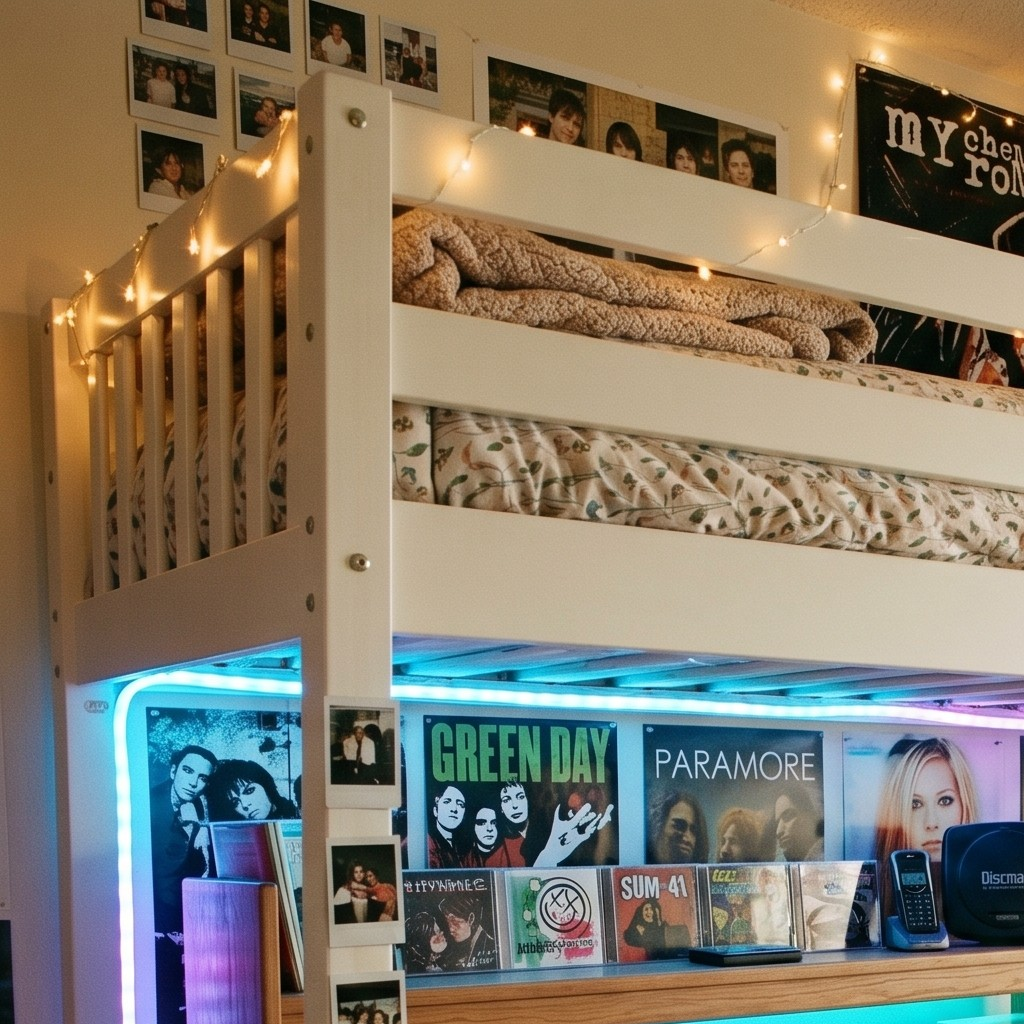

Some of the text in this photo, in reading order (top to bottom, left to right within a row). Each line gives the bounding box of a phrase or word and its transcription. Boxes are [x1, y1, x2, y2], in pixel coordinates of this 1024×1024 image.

[431, 722, 610, 784] GREEN DAY
[655, 748, 816, 781] PARAMORE
[620, 874, 660, 900] SUM
[668, 874, 688, 898] 41
